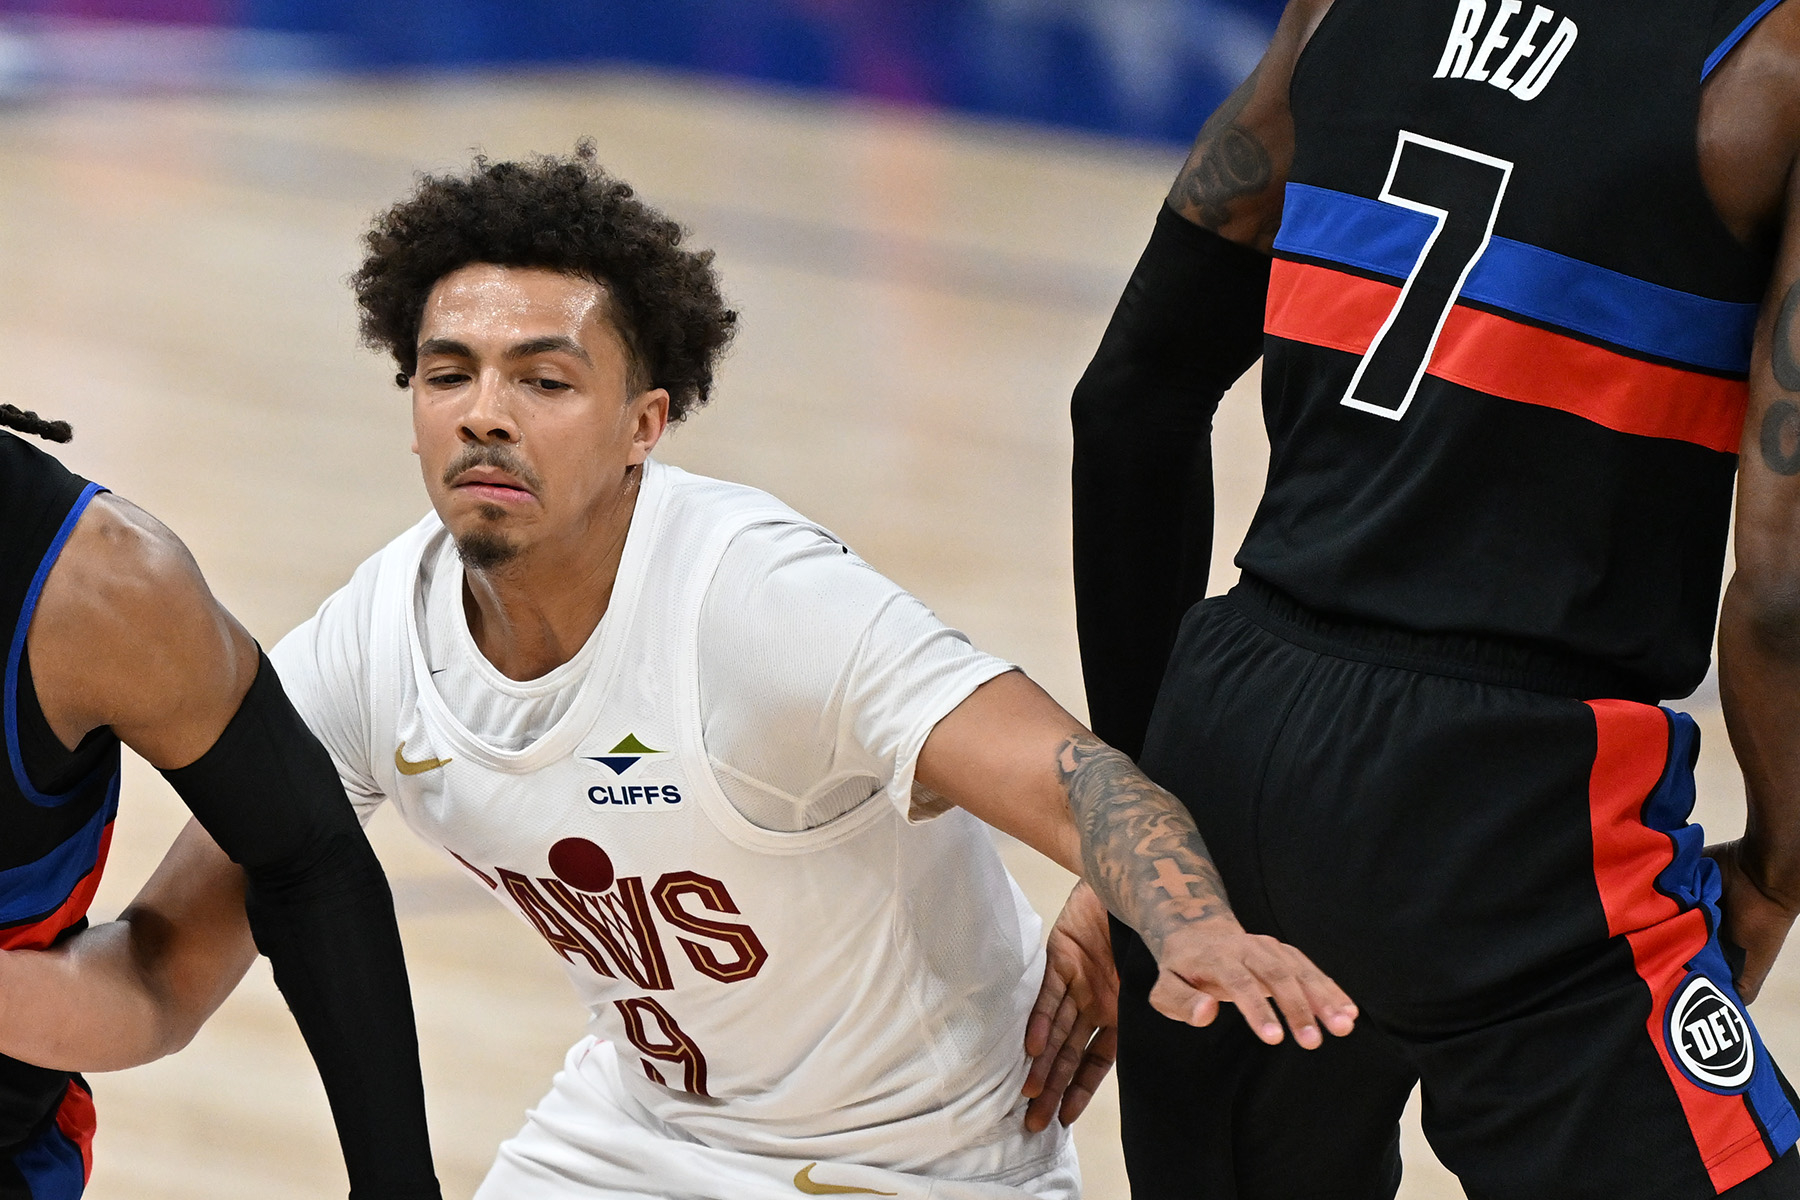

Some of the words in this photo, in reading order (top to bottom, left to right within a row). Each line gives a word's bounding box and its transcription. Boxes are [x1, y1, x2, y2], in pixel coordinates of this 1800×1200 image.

[1433, 0, 1578, 101] REED
[1340, 129, 1514, 421] 7
[588, 784, 682, 805] CLIFFS
[613, 995, 708, 1097] 9
[1684, 1005, 1741, 1061] DET
